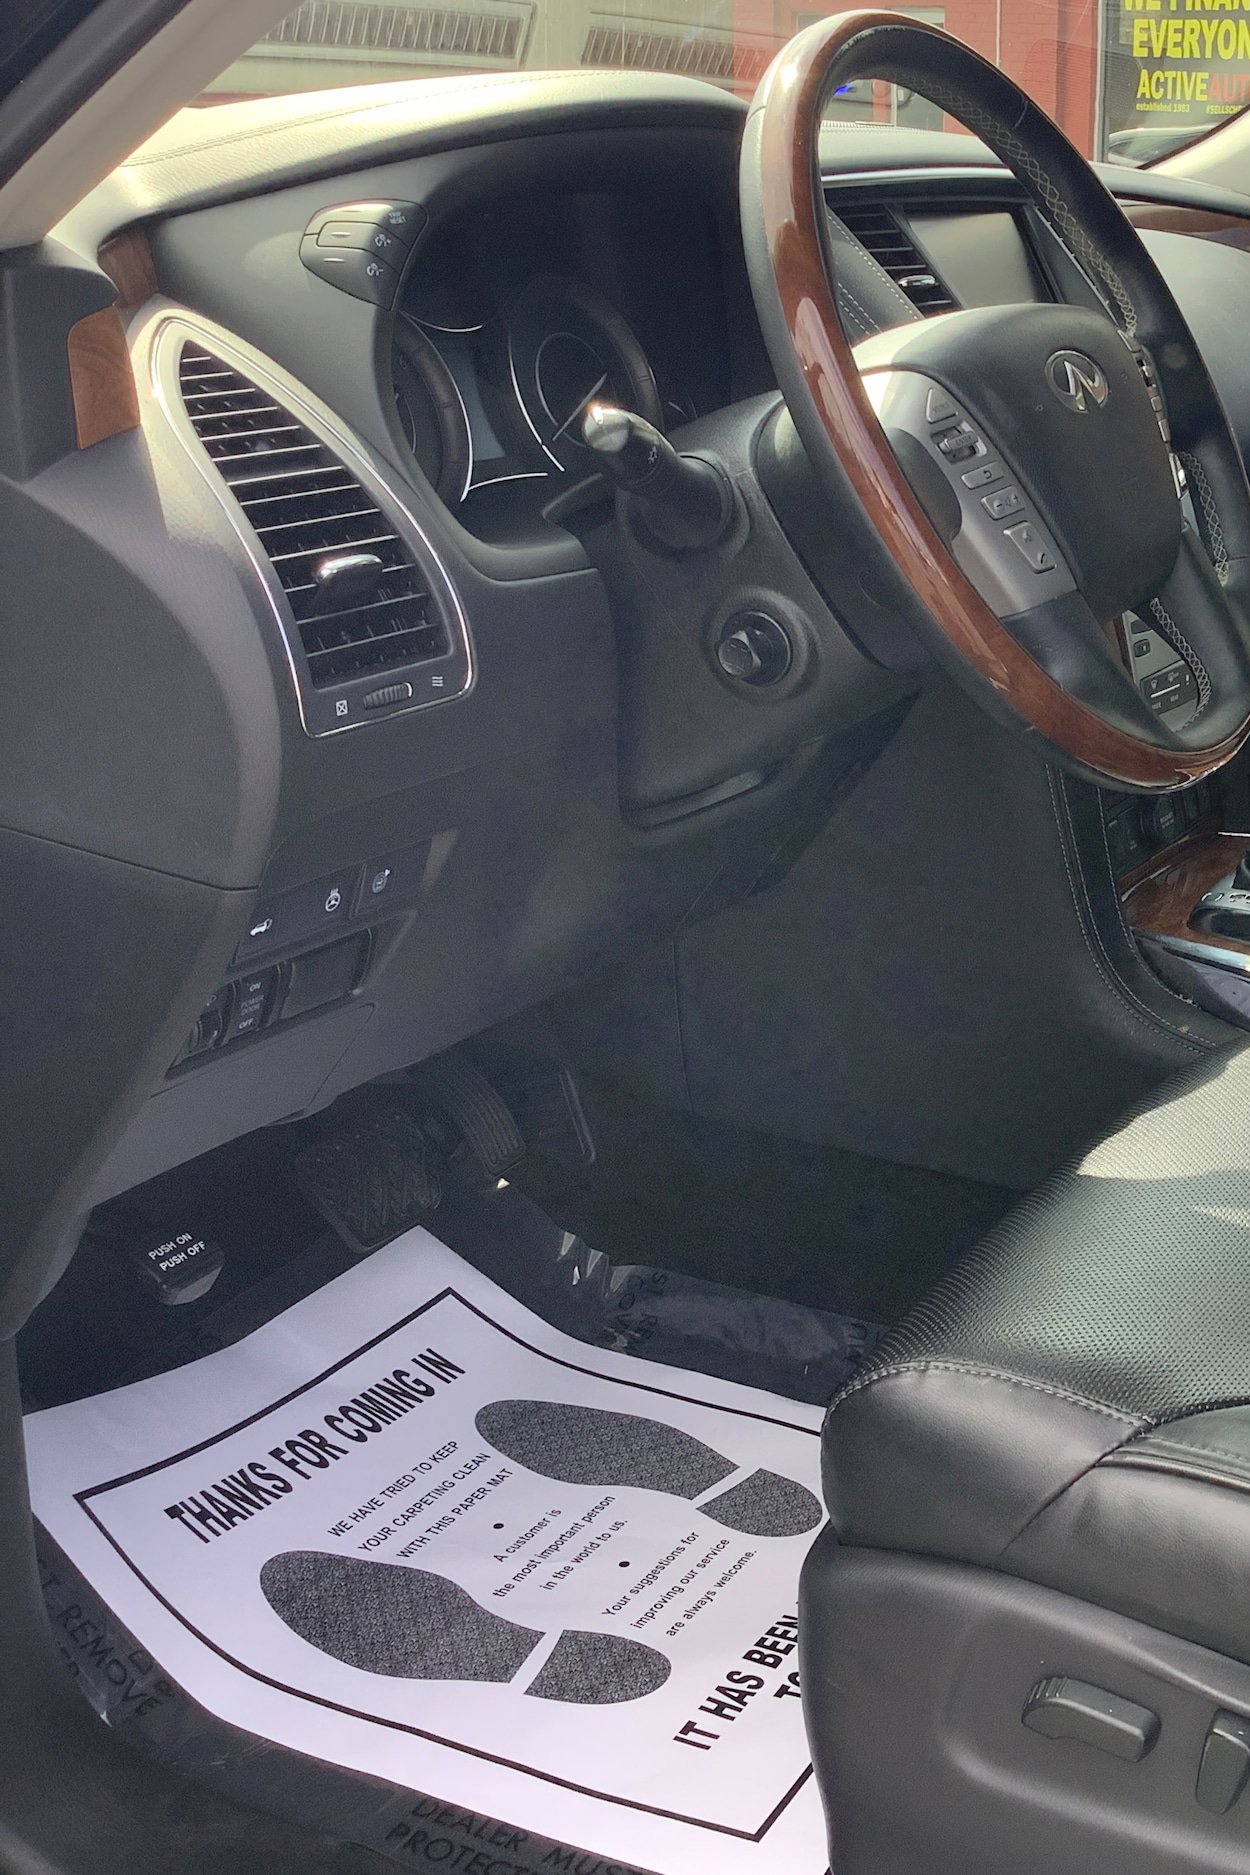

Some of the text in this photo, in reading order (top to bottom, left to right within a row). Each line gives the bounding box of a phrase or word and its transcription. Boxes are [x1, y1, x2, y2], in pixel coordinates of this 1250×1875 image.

[1173, 103, 1190, 113] 1983
[249, 981, 262, 993] ON
[148, 1232, 193, 1260] PUSH ON
[159, 1240, 206, 1271] PUSH OFF
[163, 1347, 466, 1544] THANKS FOR COMING IN
[328, 1441, 459, 1538] WE HAVE TRIED TO KEEP
[358, 1452, 491, 1552] YOUR CARPETING CLEAN
[396, 1467, 514, 1559] WITH THIS PAPER MAT
[492, 1495, 616, 1598] the most important person
[493, 1508, 562, 1563] A customer is
[539, 1519, 628, 1591] in the world to us.
[601, 1531, 700, 1617] Your suggestions for
[630, 1538, 730, 1629] improving our service
[666, 1549, 758, 1637] are always welcome.
[56, 1603, 164, 1717] REMOVE
[672, 1720, 721, 1751] IT
[698, 1670, 765, 1722] HAS
[411, 1799, 529, 1851] DEALER
